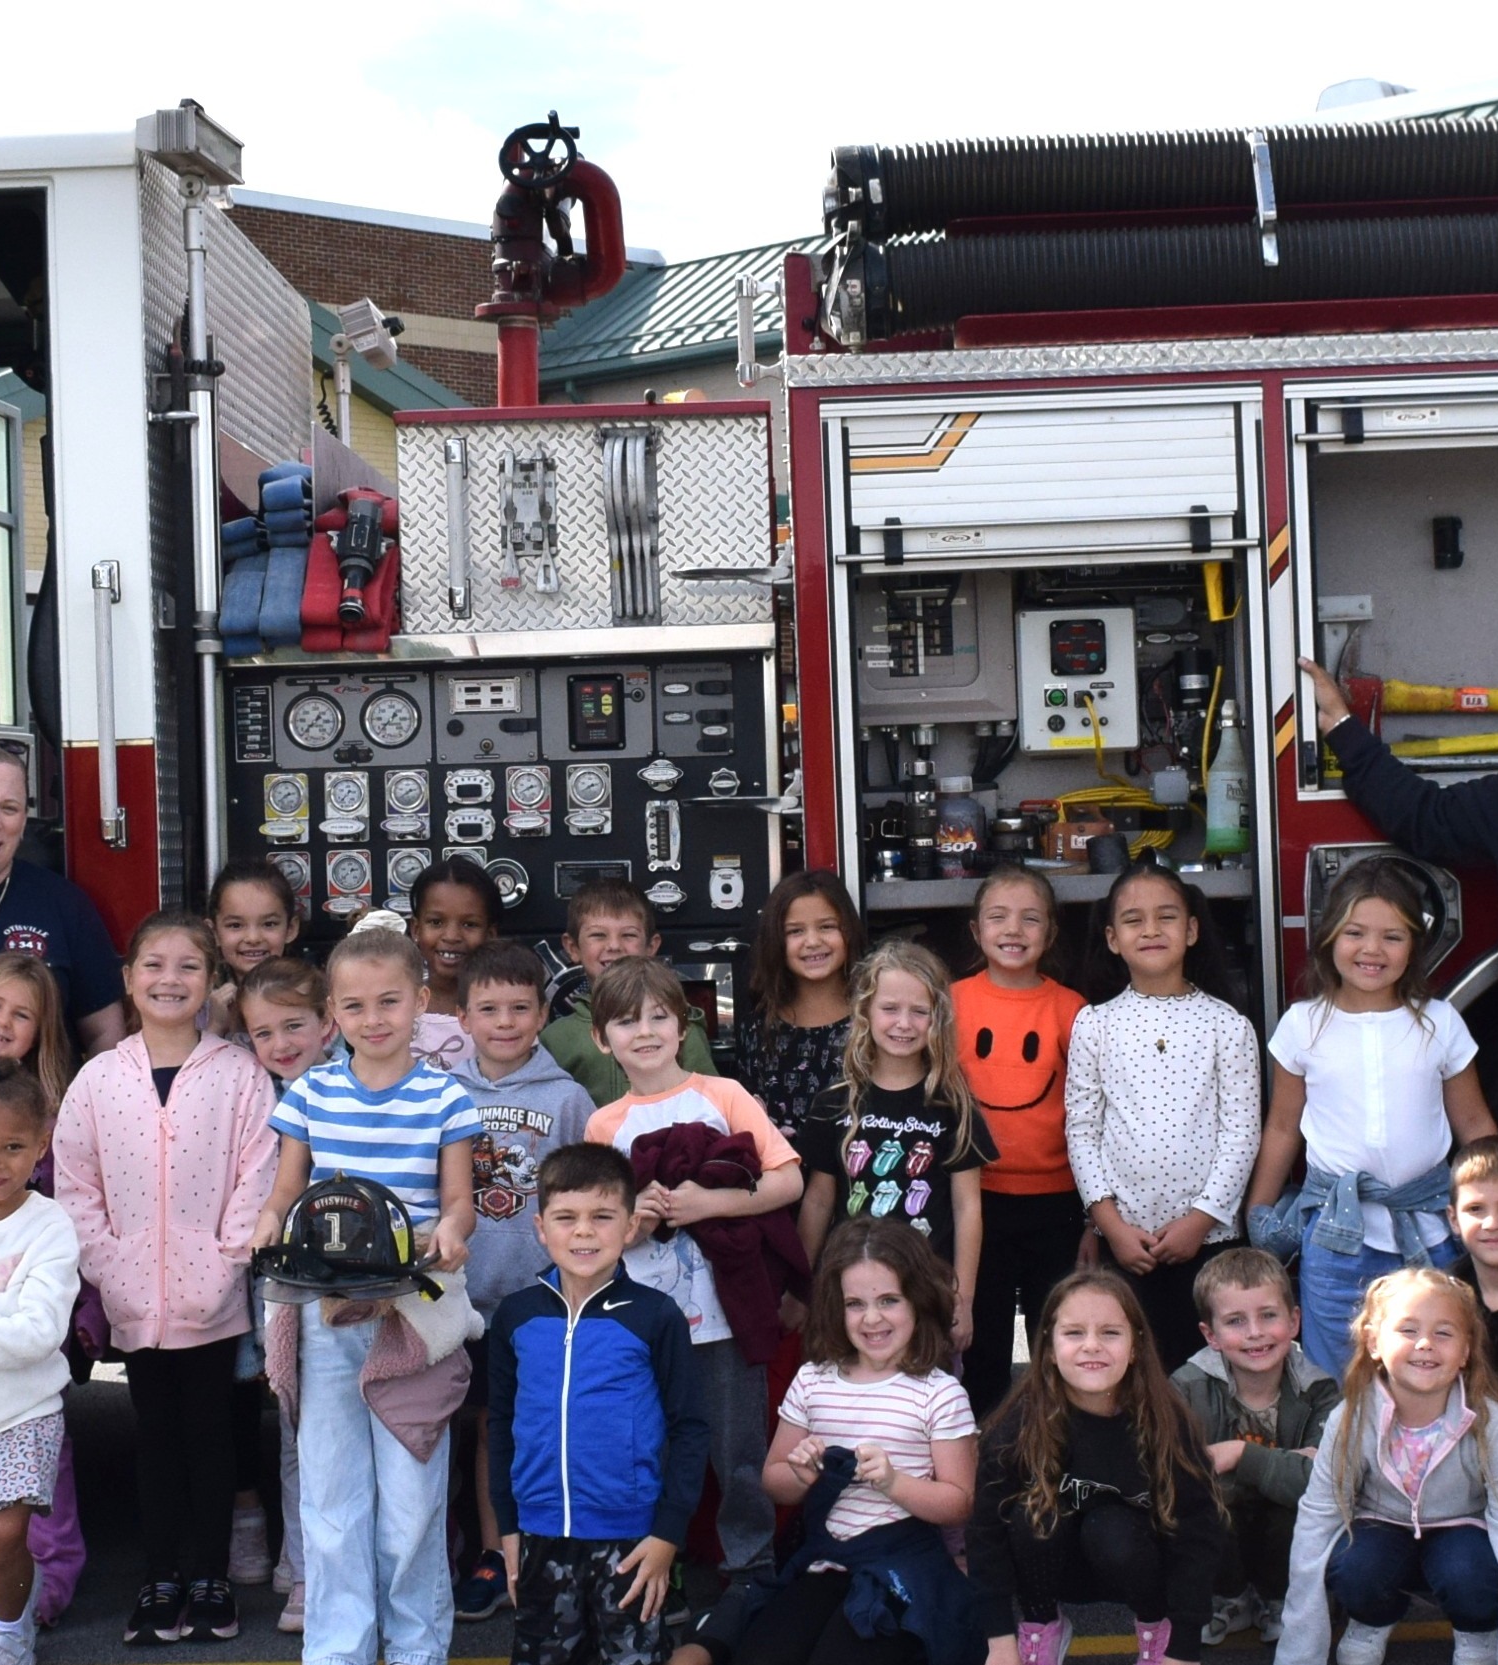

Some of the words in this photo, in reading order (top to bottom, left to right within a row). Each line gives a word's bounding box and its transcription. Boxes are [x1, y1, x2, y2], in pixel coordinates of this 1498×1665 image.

[3, 924, 50, 938] OTISVILLE
[18, 941, 34, 949] 34
[479, 1106, 525, 1124] IMMAGE
[527, 1111, 553, 1135] DAY
[482, 1121, 518, 1131] 2026
[859, 1114, 903, 1138] Rolling
[904, 1116, 947, 1137] Stones
[314, 1195, 360, 1210] OTISVILLE
[324, 1212, 347, 1252] 1
